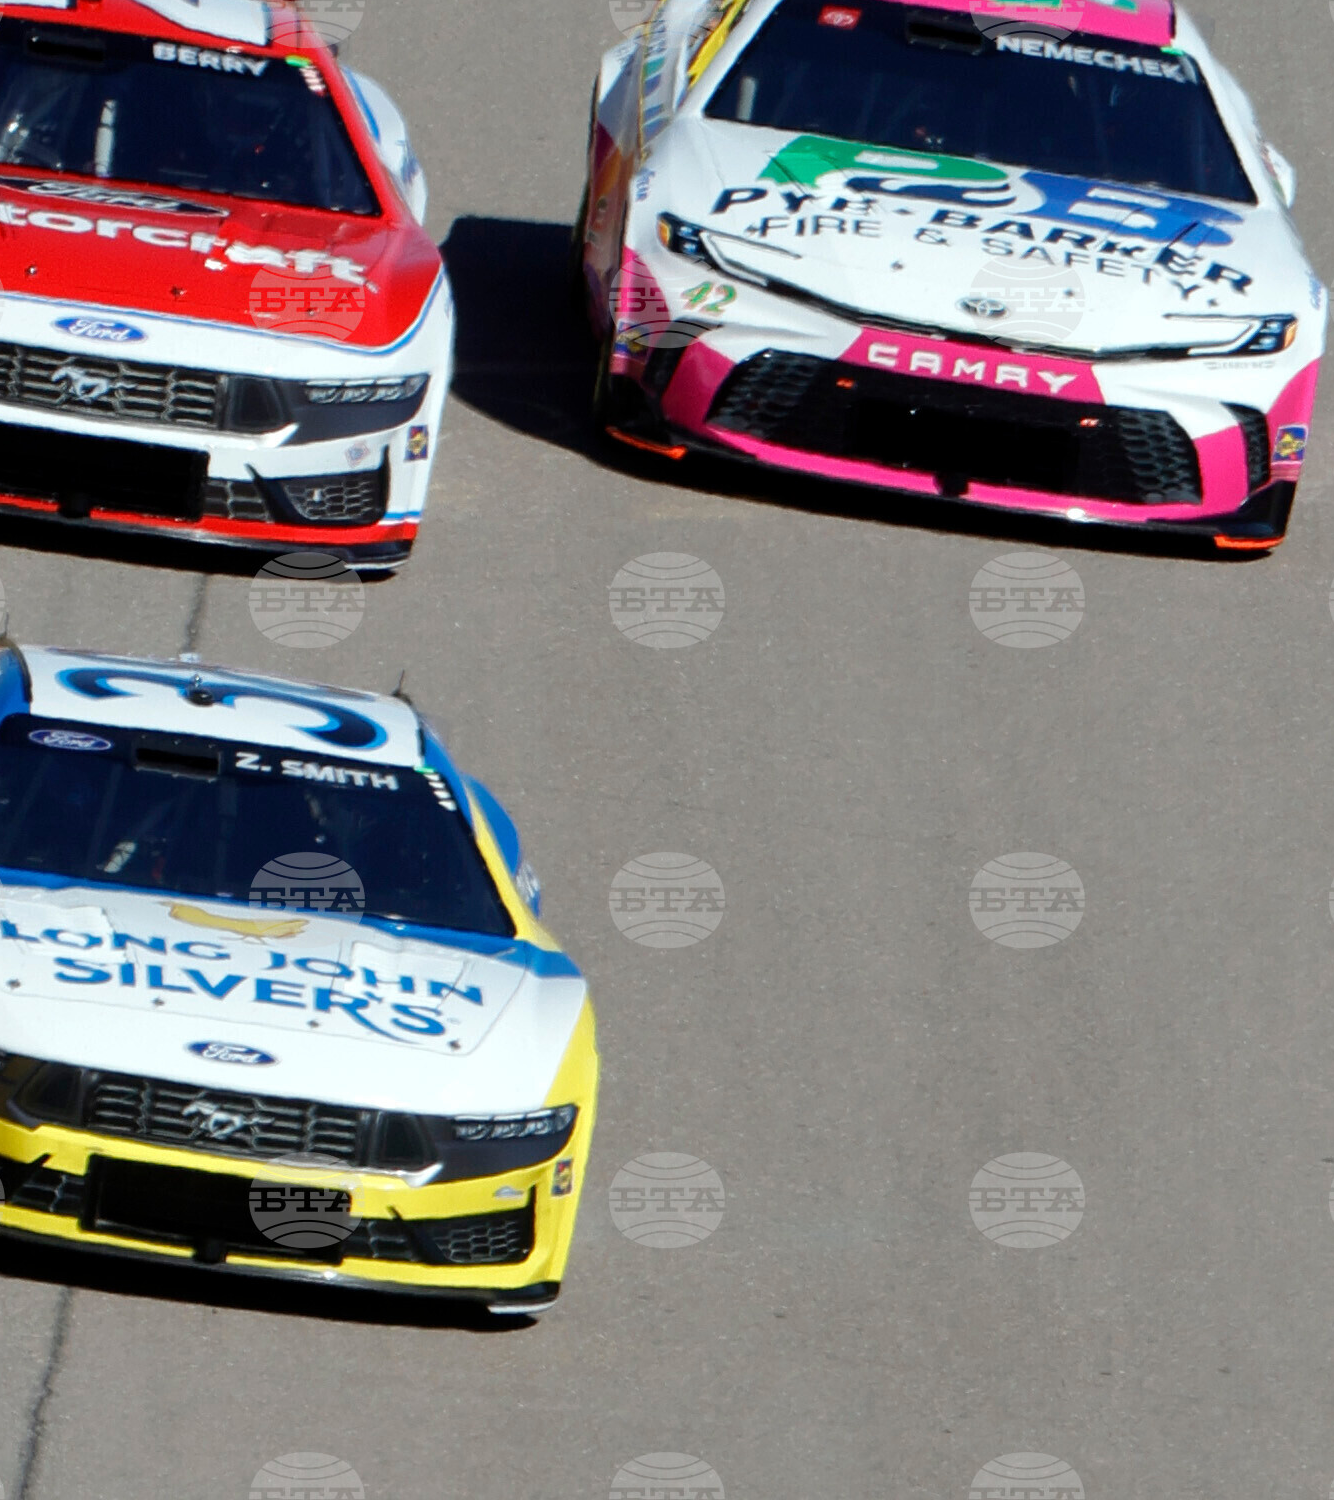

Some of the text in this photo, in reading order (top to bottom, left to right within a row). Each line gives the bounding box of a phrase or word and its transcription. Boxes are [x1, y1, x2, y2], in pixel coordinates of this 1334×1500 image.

[153, 41, 267, 78] BERRY
[995, 35, 1184, 82] NEMECHEK
[22, 180, 185, 213] Ford
[760, 215, 1202, 300] FIRE & SAFETY
[681, 280, 738, 316] 42
[60, 316, 141, 342] Ford
[867, 341, 1078, 395] CAMRY
[35, 729, 105, 751] Ford
[235, 751, 400, 791] Z. SMITH
[0, 918, 484, 1007] LONG JOHN
[191, 1040, 272, 1067] Ford
